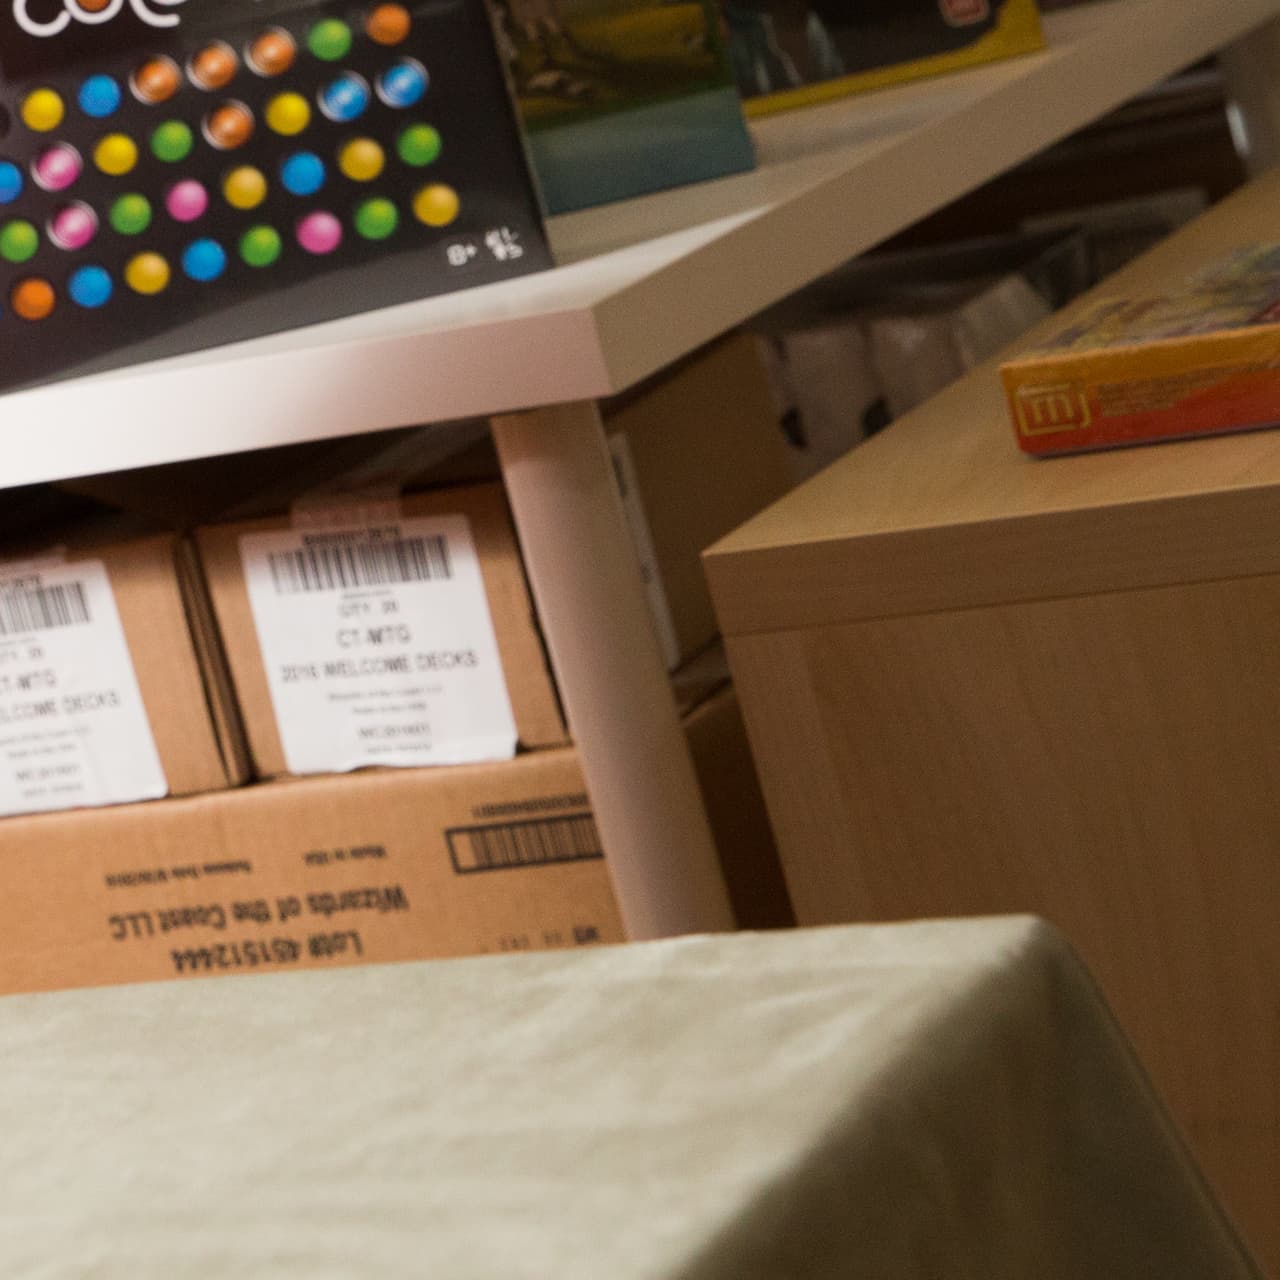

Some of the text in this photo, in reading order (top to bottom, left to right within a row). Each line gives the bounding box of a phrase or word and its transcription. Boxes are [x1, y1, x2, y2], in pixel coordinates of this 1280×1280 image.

[108, 883, 410, 941] Wizards of the Coast LLC
